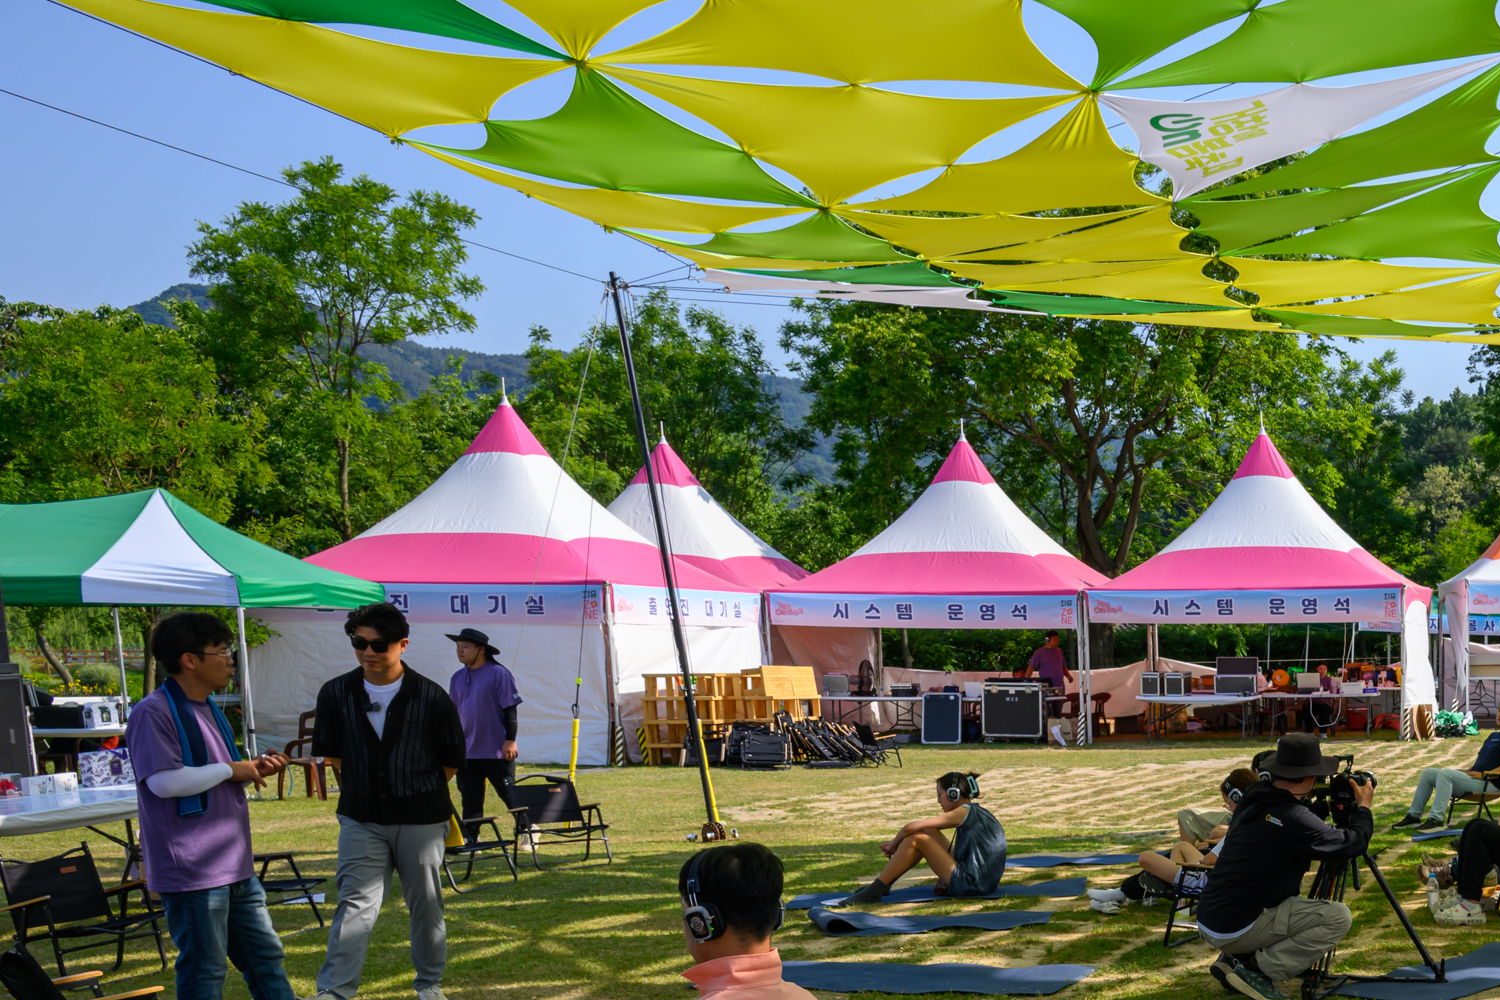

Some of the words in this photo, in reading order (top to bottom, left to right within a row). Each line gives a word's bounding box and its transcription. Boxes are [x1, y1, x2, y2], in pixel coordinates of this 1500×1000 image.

[1208, 100, 1269, 142] 거창에
[450, 594, 545, 615] 대기실
[705, 600, 741, 618] 대기실
[832, 602, 912, 620] 시스템
[947, 604, 1027, 621] 운영석
[1152, 599, 1233, 616] 시스템
[1269, 597, 1350, 615] 운영석
